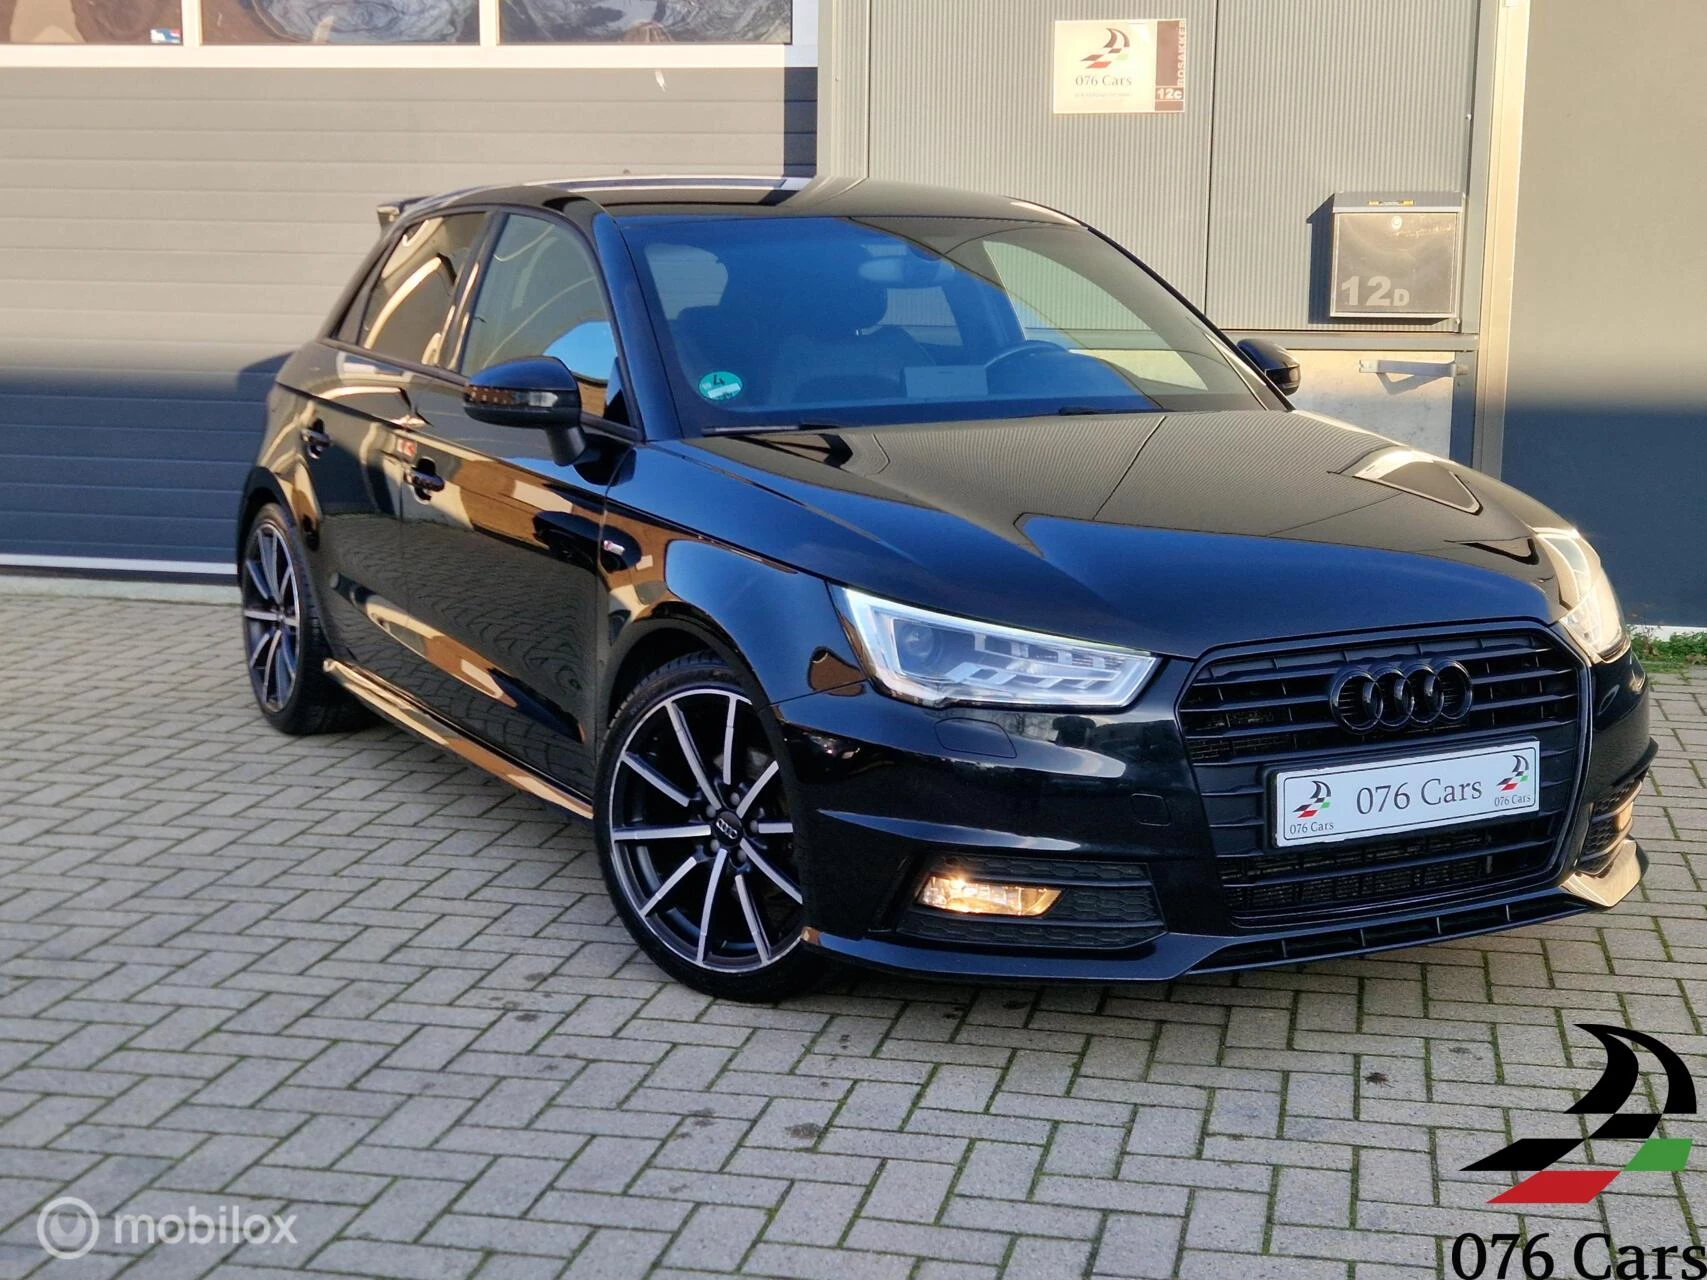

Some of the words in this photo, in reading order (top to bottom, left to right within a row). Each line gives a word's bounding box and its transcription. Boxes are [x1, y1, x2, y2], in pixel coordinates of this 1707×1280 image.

[1075, 75, 1098, 86] 076
[1102, 74, 1132, 86] Cars
[1356, 782, 1410, 814] 076
[1421, 778, 1482, 805] Cars
[1494, 796, 1510, 807] 076
[1511, 794, 1531, 804] Cars
[1290, 823, 1308, 835] 076
[1310, 821, 1334, 832] Cars
